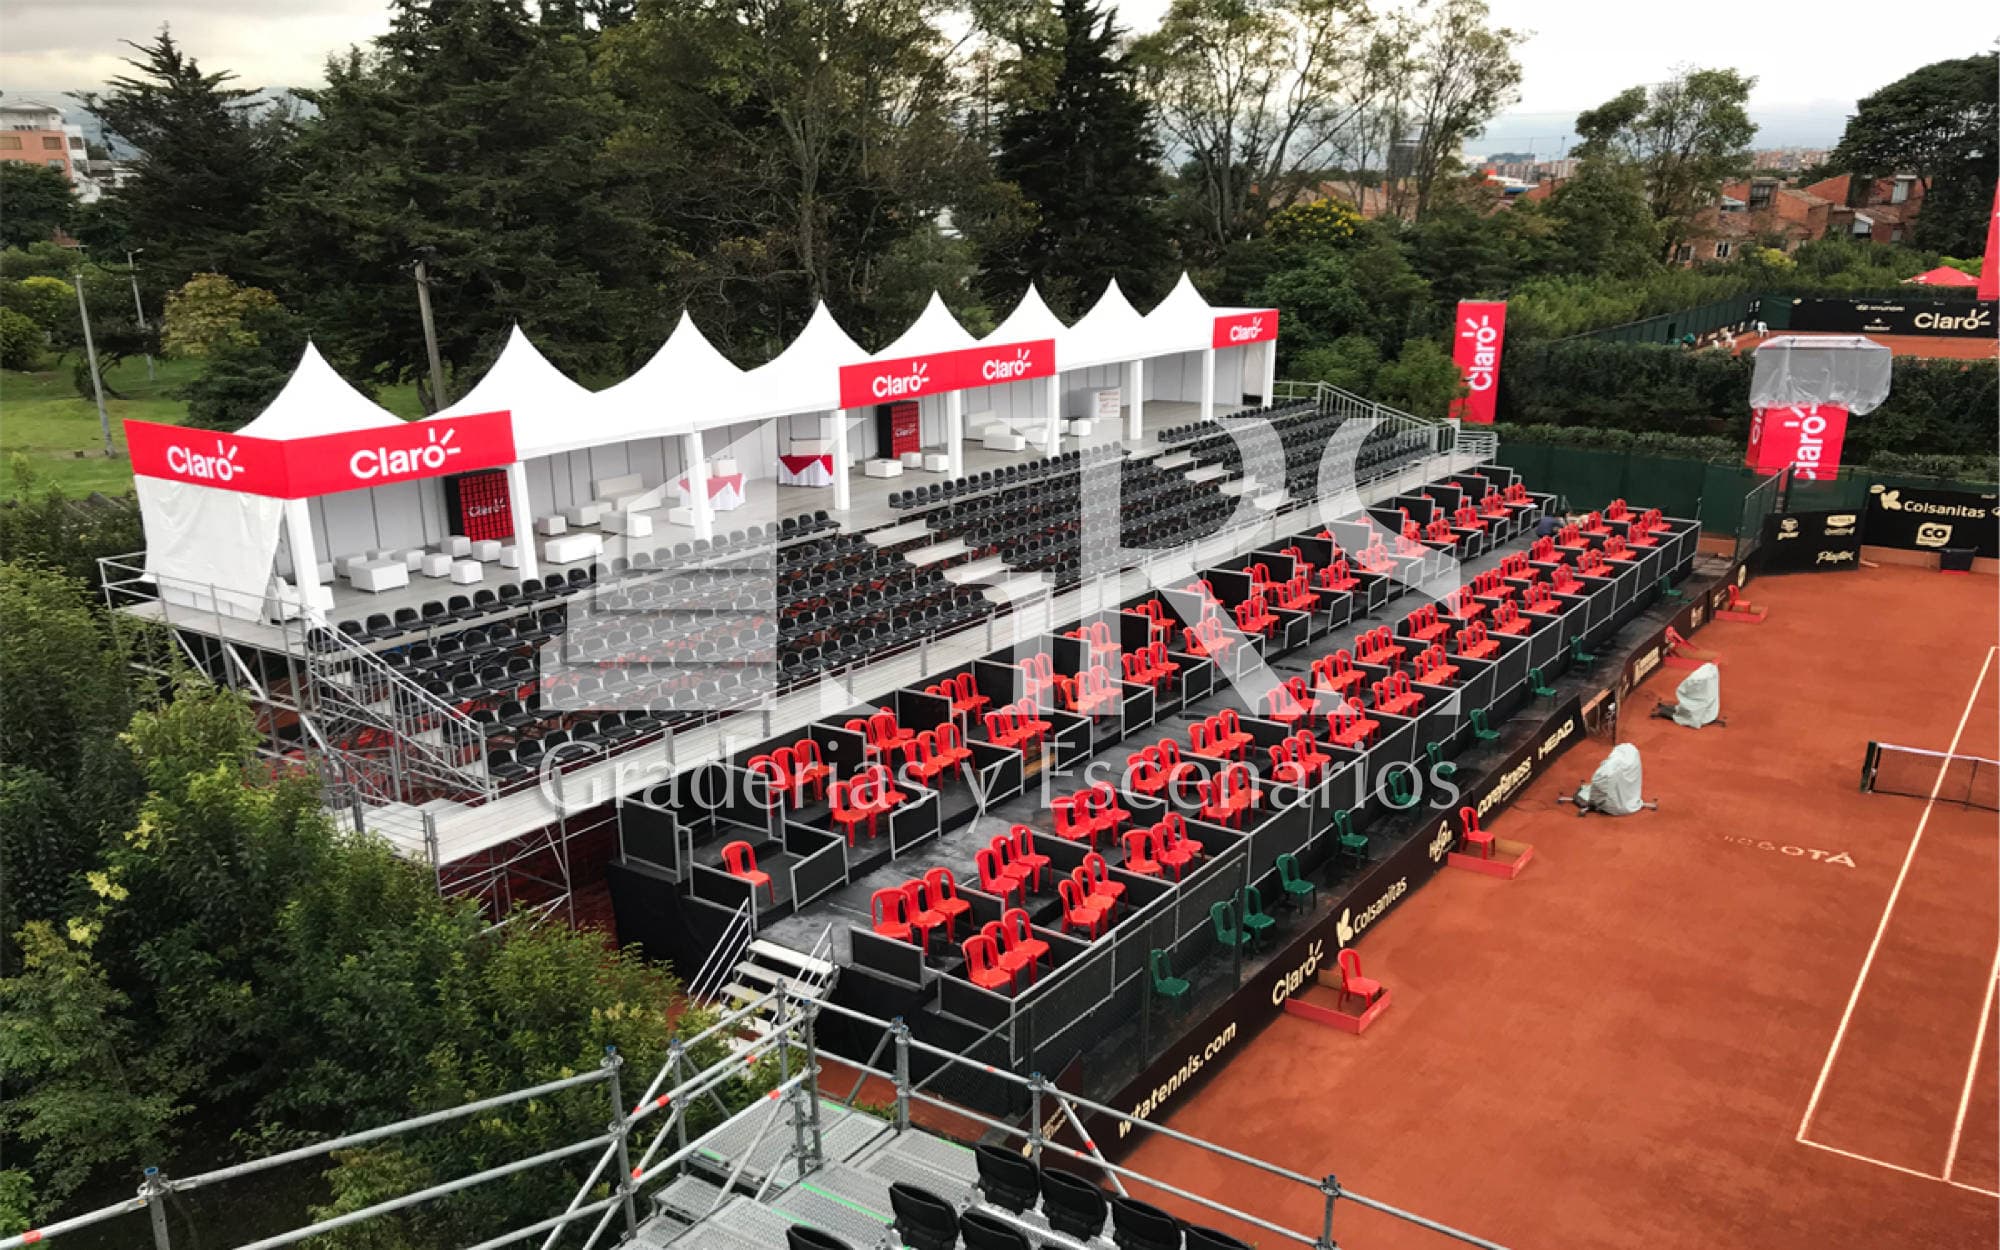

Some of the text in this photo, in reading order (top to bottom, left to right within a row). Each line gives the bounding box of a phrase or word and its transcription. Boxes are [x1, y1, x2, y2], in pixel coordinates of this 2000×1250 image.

[1229, 323, 1258, 342] Claro
[1914, 312, 1979, 331] Claro
[982, 359, 1026, 382] Claro
[1467, 326, 1498, 391] Claro
[872, 374, 921, 398] Claro
[167, 446, 234, 482] Claro
[350, 444, 447, 479] Claro
[1904, 501, 1985, 518] Colsanitas
[1538, 719, 1574, 760] HEAD
[1353, 876, 1407, 934] Colsanitas
[1272, 956, 1316, 1006] Claro
[1118, 1021, 1237, 1139] wtatennis.com
